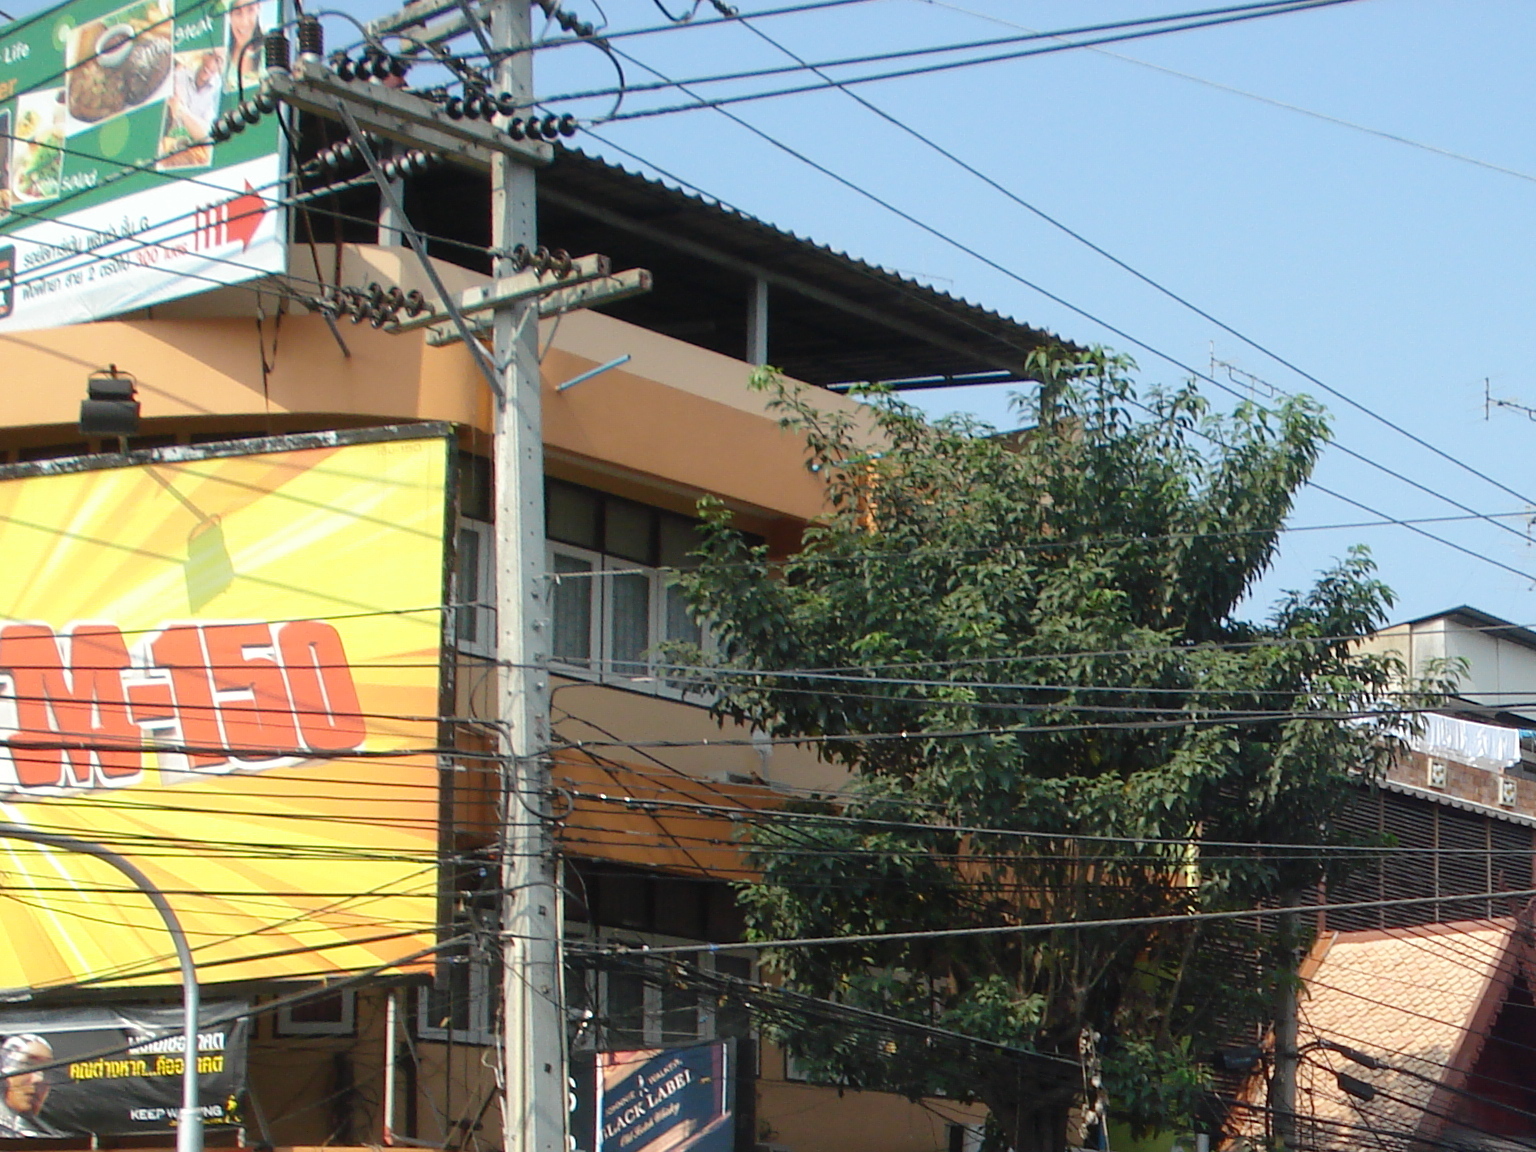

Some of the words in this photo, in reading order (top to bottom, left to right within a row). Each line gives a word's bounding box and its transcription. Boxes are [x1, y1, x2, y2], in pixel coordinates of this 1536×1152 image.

[87, 266, 96, 281] 2
[135, 248, 159, 267] 300
[130, 1107, 165, 1121] KEEP
